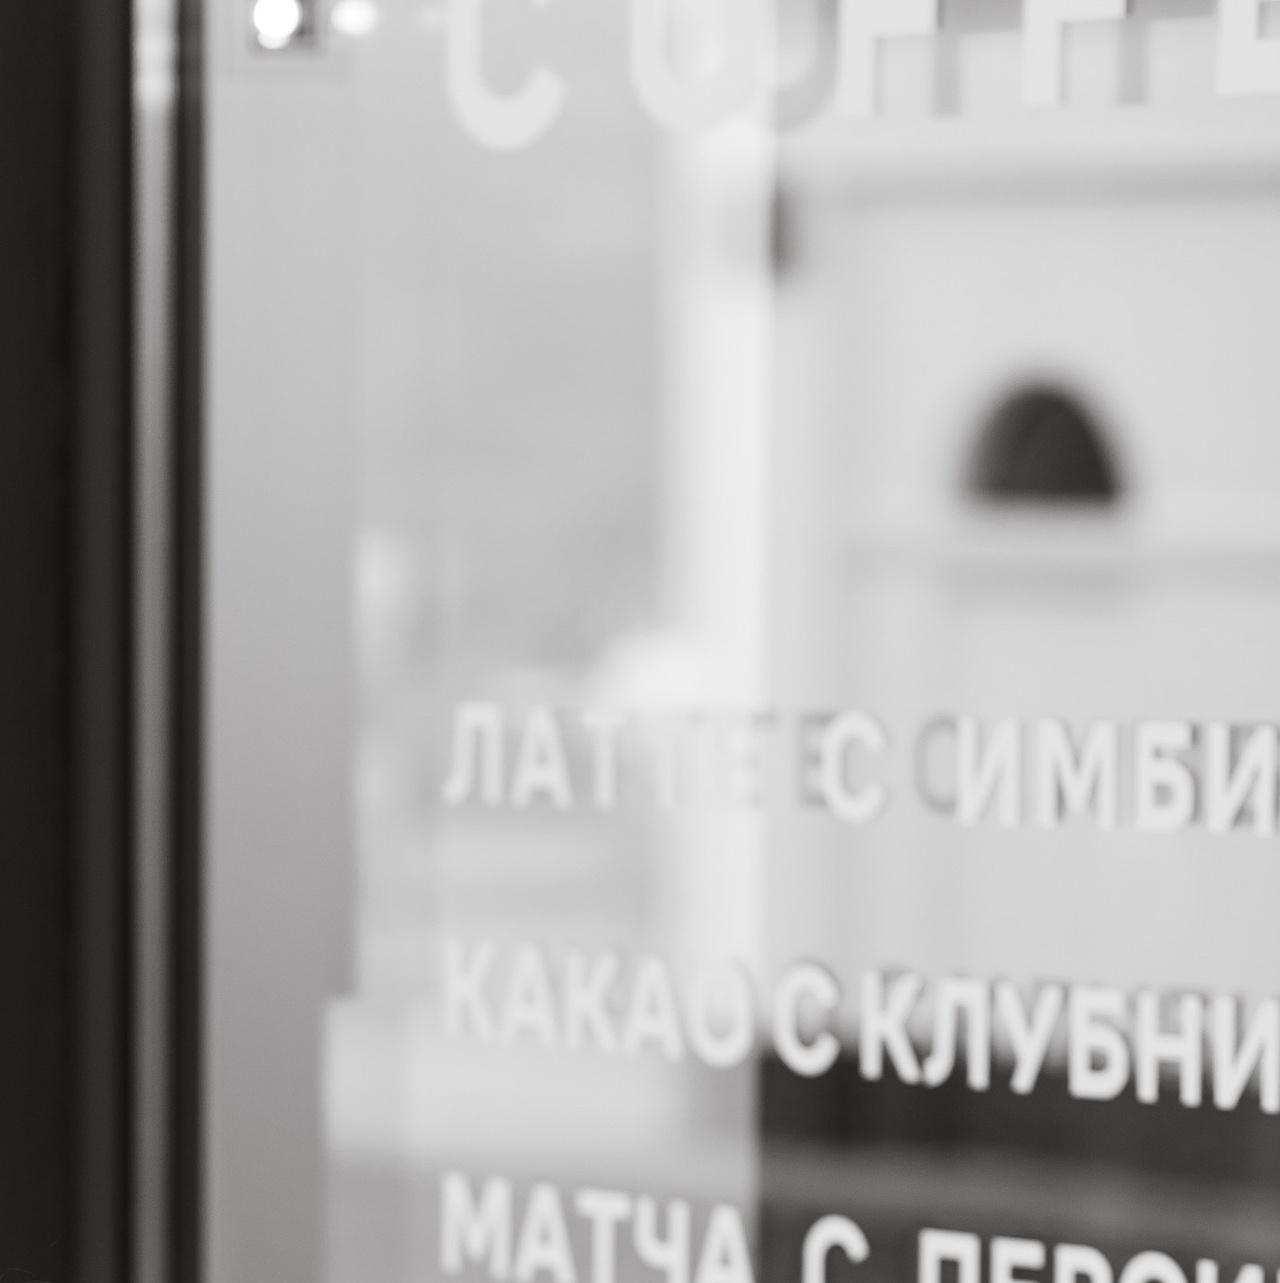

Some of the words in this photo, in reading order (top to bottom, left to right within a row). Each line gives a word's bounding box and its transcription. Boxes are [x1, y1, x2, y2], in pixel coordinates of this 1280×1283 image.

[822, 711, 887, 825] С
[956, 716, 1278, 839] ИМБИ
[440, 936, 756, 1070] КАКАО
[771, 958, 842, 1078] С
[858, 968, 1280, 1116] КЛУБНИ
